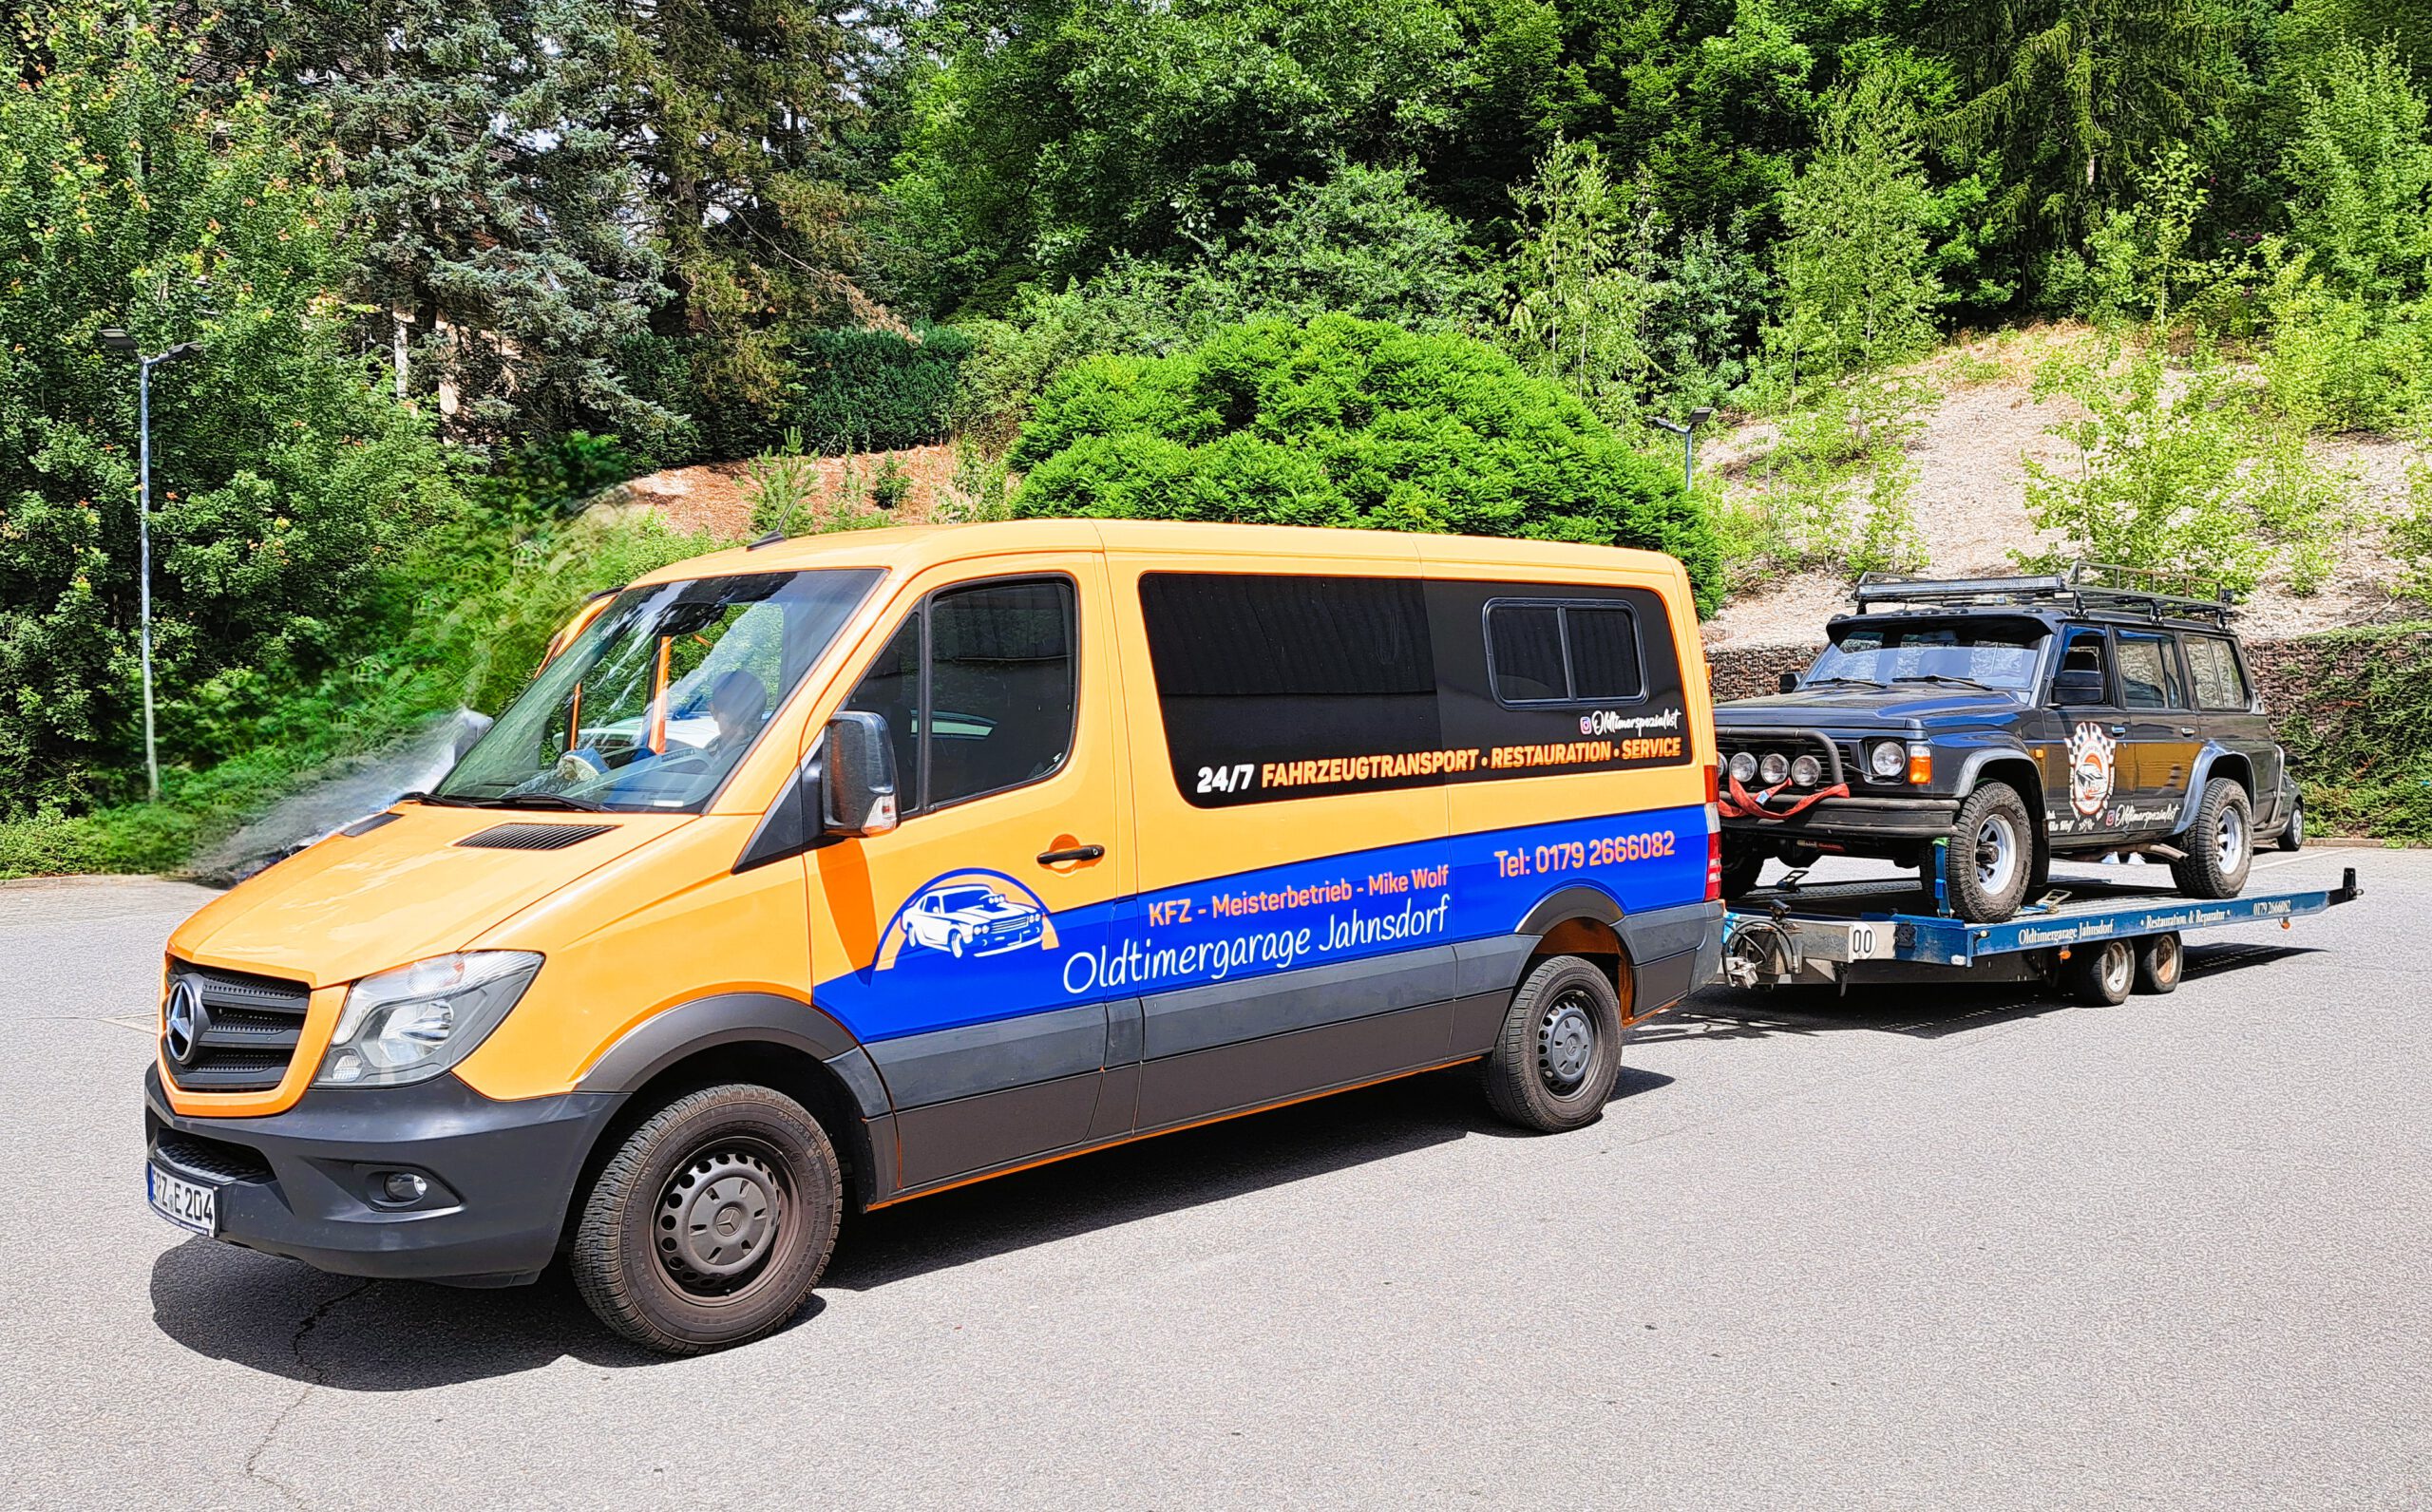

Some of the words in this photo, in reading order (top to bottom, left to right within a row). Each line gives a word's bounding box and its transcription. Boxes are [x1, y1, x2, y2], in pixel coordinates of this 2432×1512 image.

[1591, 708, 1682, 737] Oldtimerspezialist
[1197, 764, 1255, 794] 24/7
[1261, 748, 1479, 788] FAHRZEUGTRANSPORT
[1491, 741, 1611, 769] RESTAURATION
[1622, 736, 1682, 760] SERVICE
[1494, 847, 1530, 878] Tel:
[1535, 841, 1585, 873] 0179
[1589, 830, 1675, 866] 2666082
[1149, 898, 1192, 927] KFZ
[1211, 879, 1353, 917] Meisterbetrieb
[1368, 871, 1409, 896] Mike
[1411, 864, 1450, 889] Wolf
[1063, 928, 1311, 994] Oldtimergarage
[1319, 894, 1451, 952] Jahnsdorf
[2018, 926, 2078, 945] Oldtimergarage
[2079, 918, 2115, 940] Jahnsdorf
[2146, 912, 2187, 930] Restauration
[2188, 910, 2194, 924] &
[2195, 909, 2226, 927] Reparatur
[2252, 901, 2268, 917] 0179
[174, 1181, 182, 1215] E
[184, 1186, 214, 1225] 204
